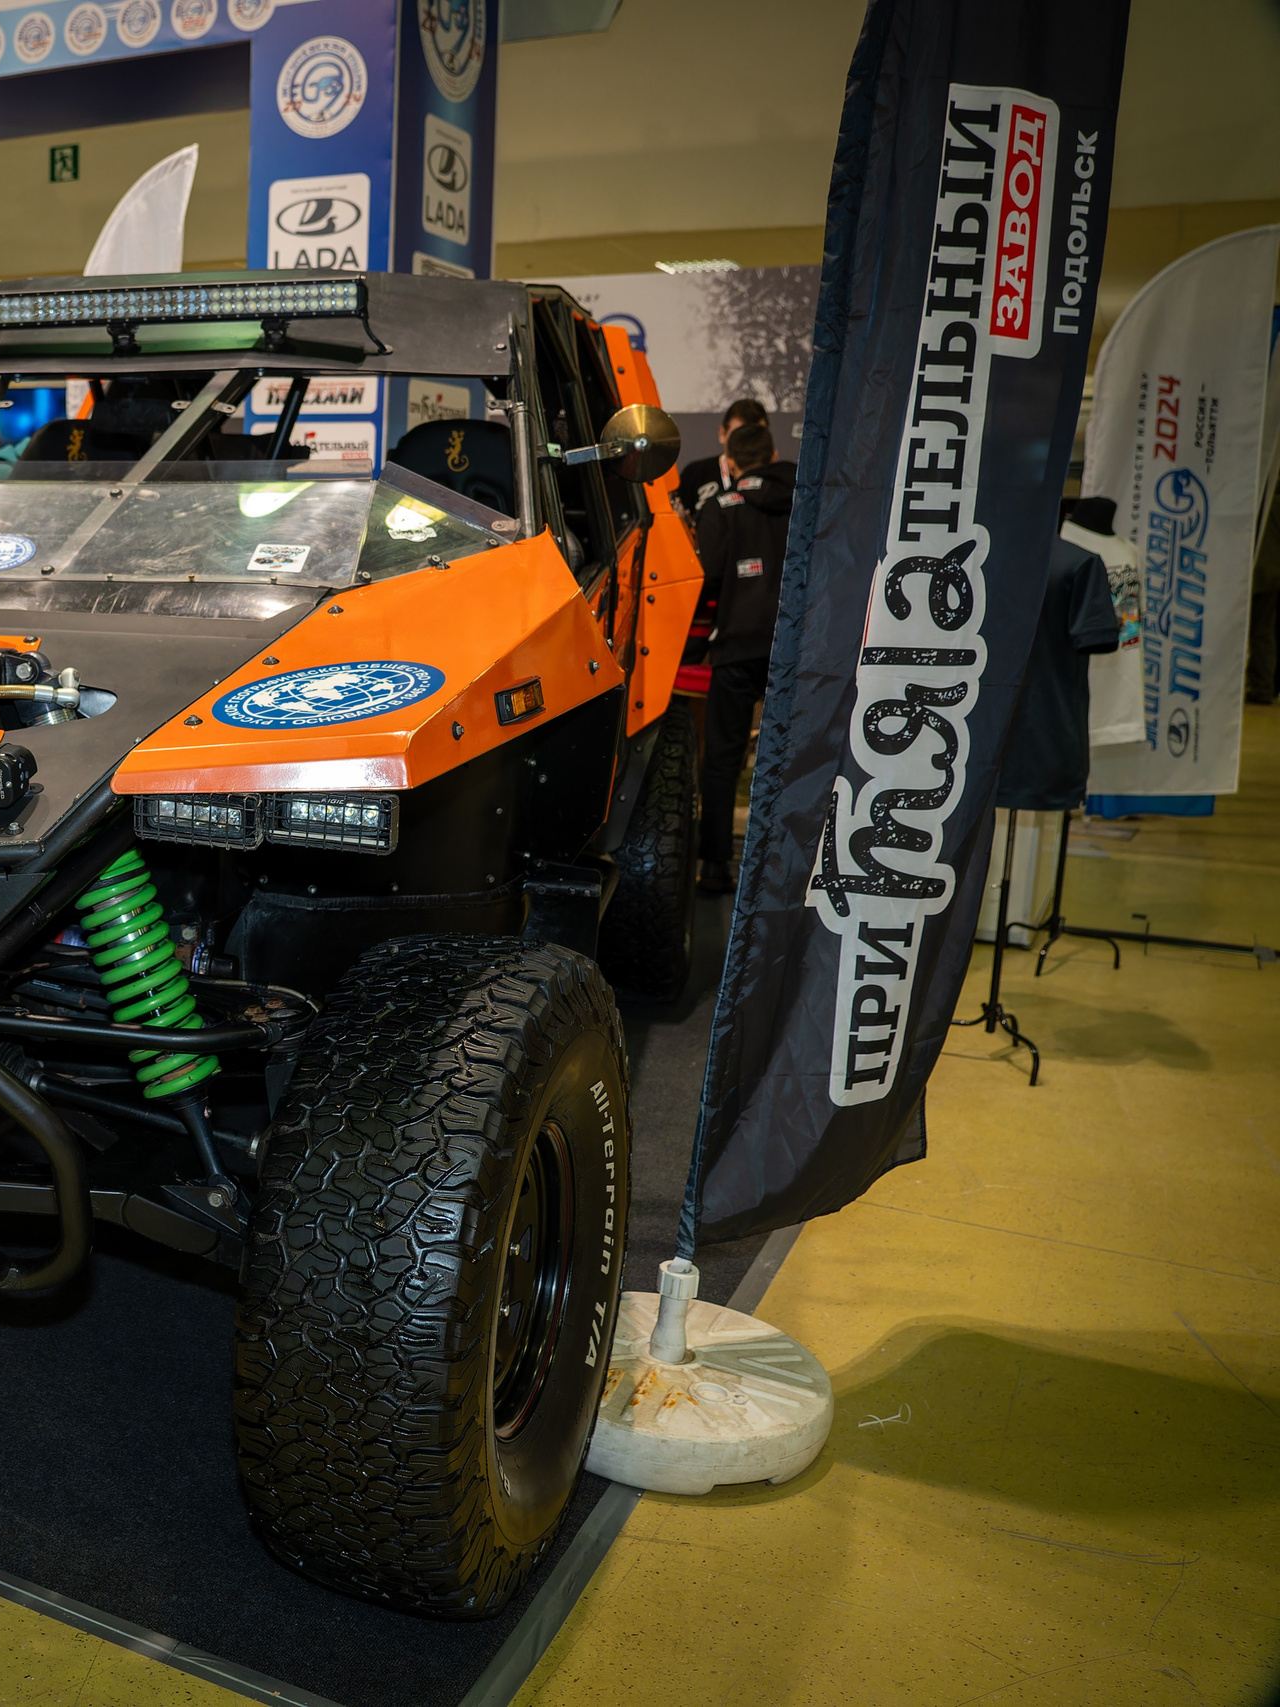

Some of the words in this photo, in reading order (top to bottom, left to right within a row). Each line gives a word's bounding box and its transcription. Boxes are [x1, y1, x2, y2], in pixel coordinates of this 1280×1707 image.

[425, 195, 467, 237] LADA
[996, 112, 1046, 331] ЗАВОД
[1052, 129, 1099, 335] Подольск
[273, 246, 360, 270] LADA
[1153, 374, 1181, 463] 2024
[231, 664, 353, 706] ГЕОГРАФИЧЕСКОЕ
[356, 662, 432, 683] ОБЩЕСТВО
[224, 702, 272, 726] РУССКОЕ
[292, 703, 390, 725] ОСНОВАНО
[389, 699, 401, 707] В
[400, 687, 425, 702] 1845
[589, 1080, 616, 1276] All-Terrain
[584, 1301, 607, 1368] T/A
